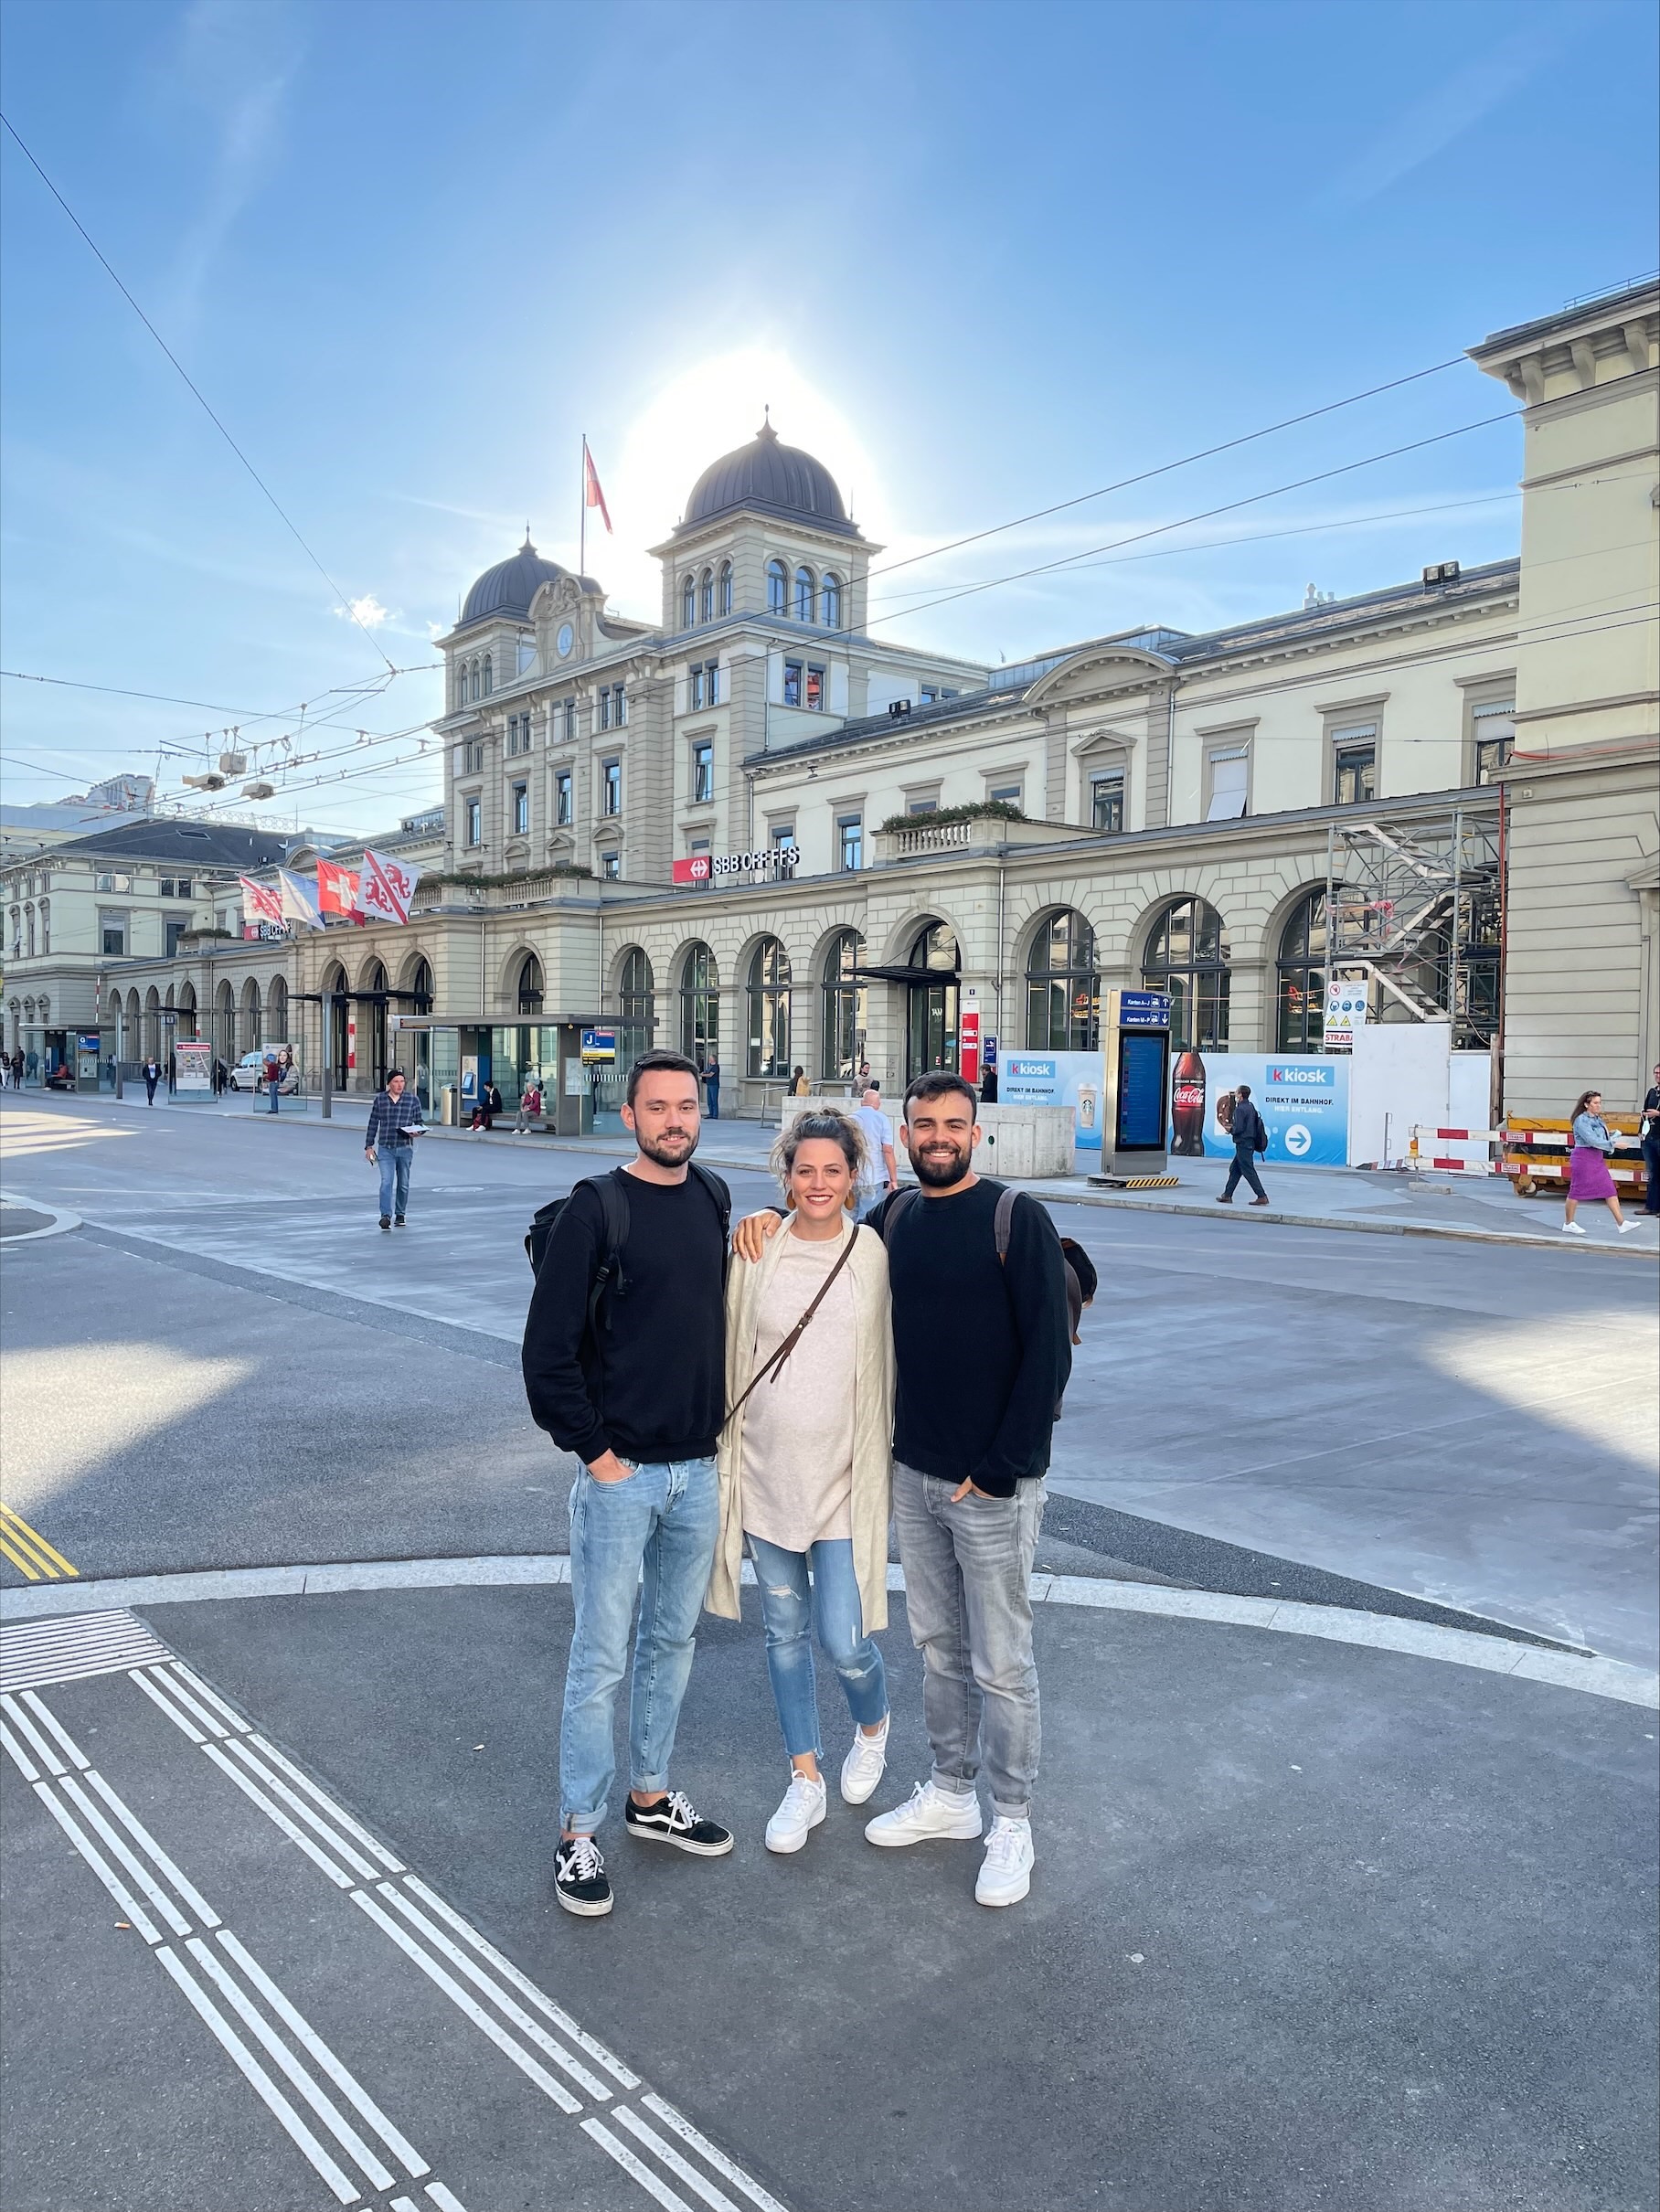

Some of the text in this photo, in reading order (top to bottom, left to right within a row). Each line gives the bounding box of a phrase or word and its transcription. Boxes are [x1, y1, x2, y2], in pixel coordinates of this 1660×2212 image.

[713, 845, 799, 875] SBB CFF FFS
[586, 1035, 593, 1045] J
[1020, 1062, 1050, 1076] kiosk
[1284, 1068, 1326, 1083] kiosk
[1301, 1098, 1334, 1106] BAHNHOF.
